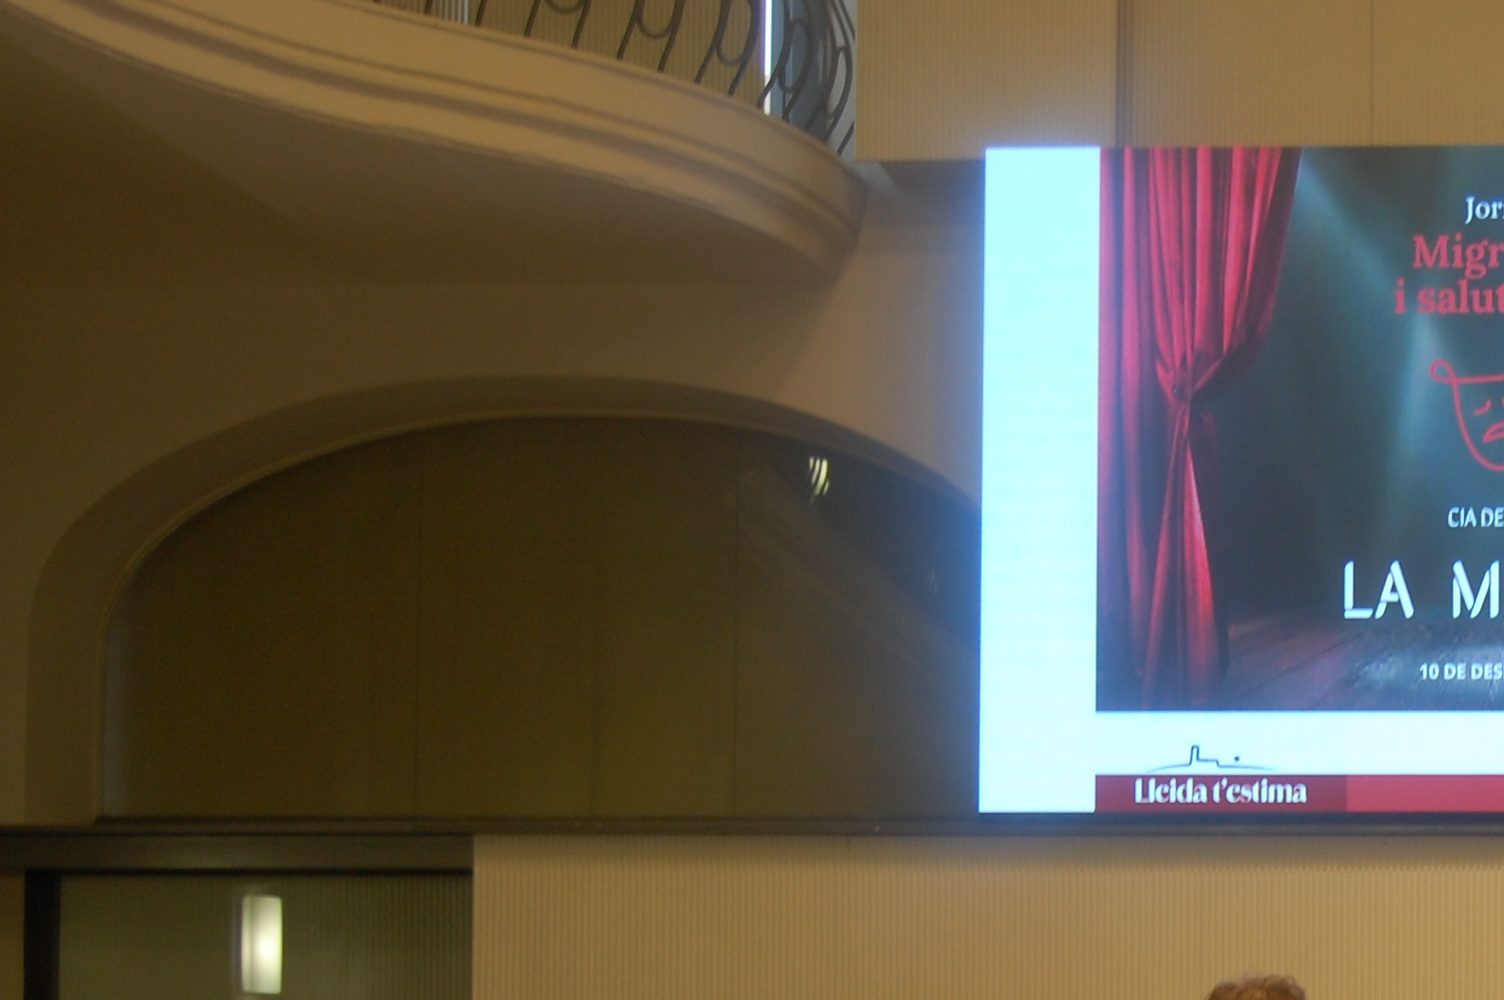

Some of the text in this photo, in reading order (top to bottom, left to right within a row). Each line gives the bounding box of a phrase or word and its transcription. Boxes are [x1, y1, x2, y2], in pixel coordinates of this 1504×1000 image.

[1394, 279, 1407, 314] i
[1448, 506, 1477, 528] CIA
[1481, 506, 1504, 528] DE
[1344, 560, 1415, 619] LA
[1419, 662, 1439, 681] 10
[1444, 662, 1466, 681] DE
[1134, 777, 1208, 804] Lleida
